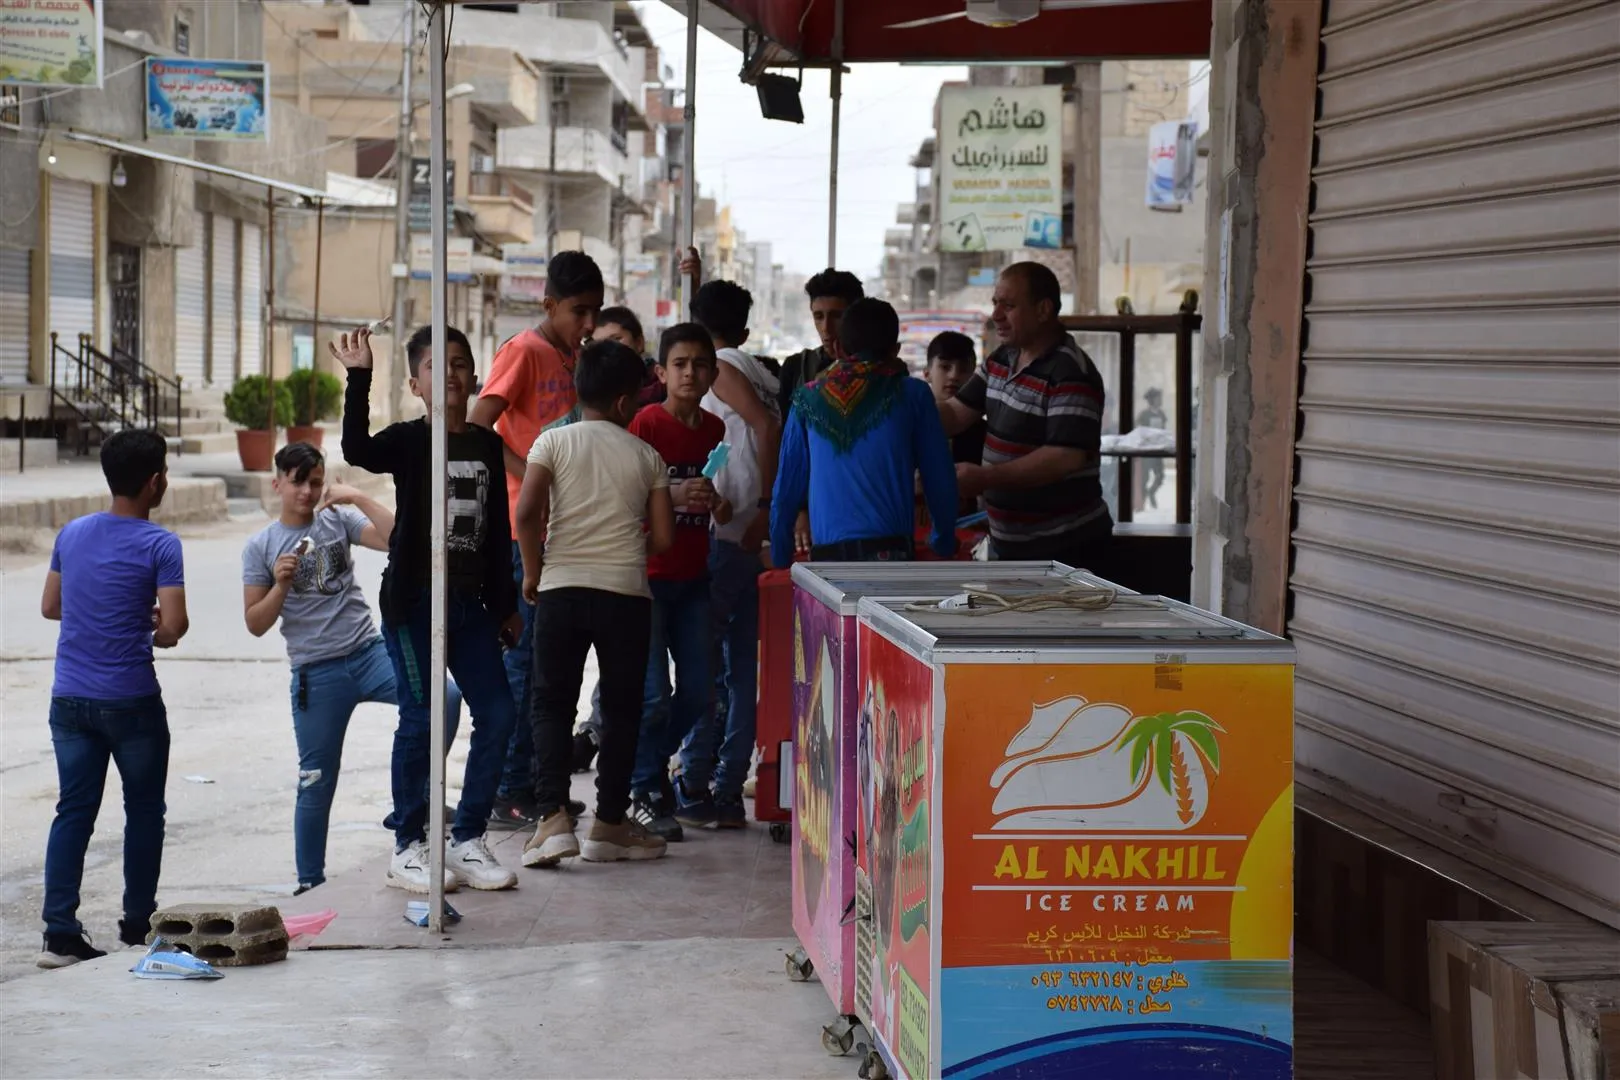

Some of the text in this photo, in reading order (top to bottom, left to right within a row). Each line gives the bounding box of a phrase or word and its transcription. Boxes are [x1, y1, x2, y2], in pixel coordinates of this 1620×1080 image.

[958, 96, 1045, 137] هاشم
[952, 144, 1048, 172] للسيراميك
[993, 844, 1227, 880] AL NAKHIL
[1025, 893, 1195, 912] ICE CREAM
[1026, 925, 1057, 944] كريم
[1107, 925, 1147, 942] النخيل
[1152, 925, 1191, 942] شركة
[1147, 970, 1189, 994] خلوي
[1138, 994, 1172, 1015] محل
